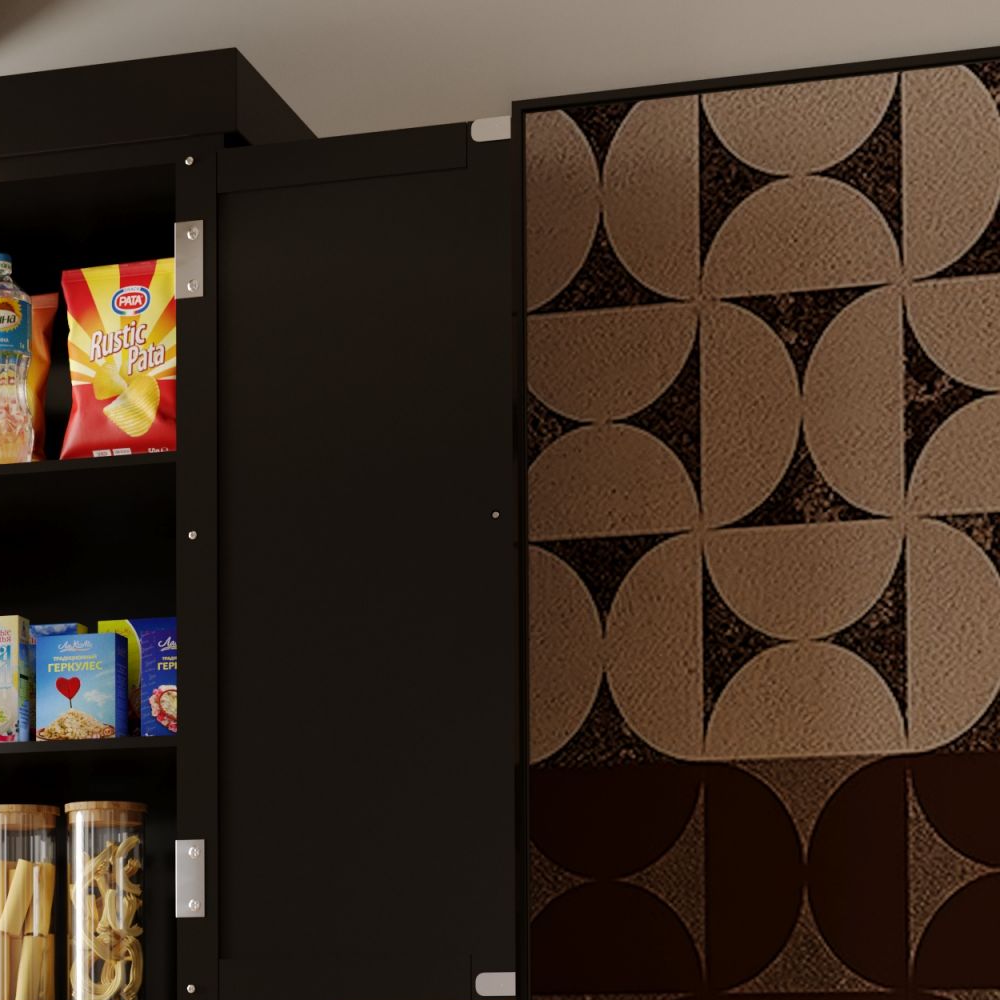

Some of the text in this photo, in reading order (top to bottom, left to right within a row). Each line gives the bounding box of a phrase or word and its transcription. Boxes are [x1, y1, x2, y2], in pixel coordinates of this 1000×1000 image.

[118, 294, 142, 306] PATA
[90, 320, 148, 362] Rustic
[127, 342, 166, 376] Pata
[47, 661, 103, 673] ГЕРКУЛЕС
